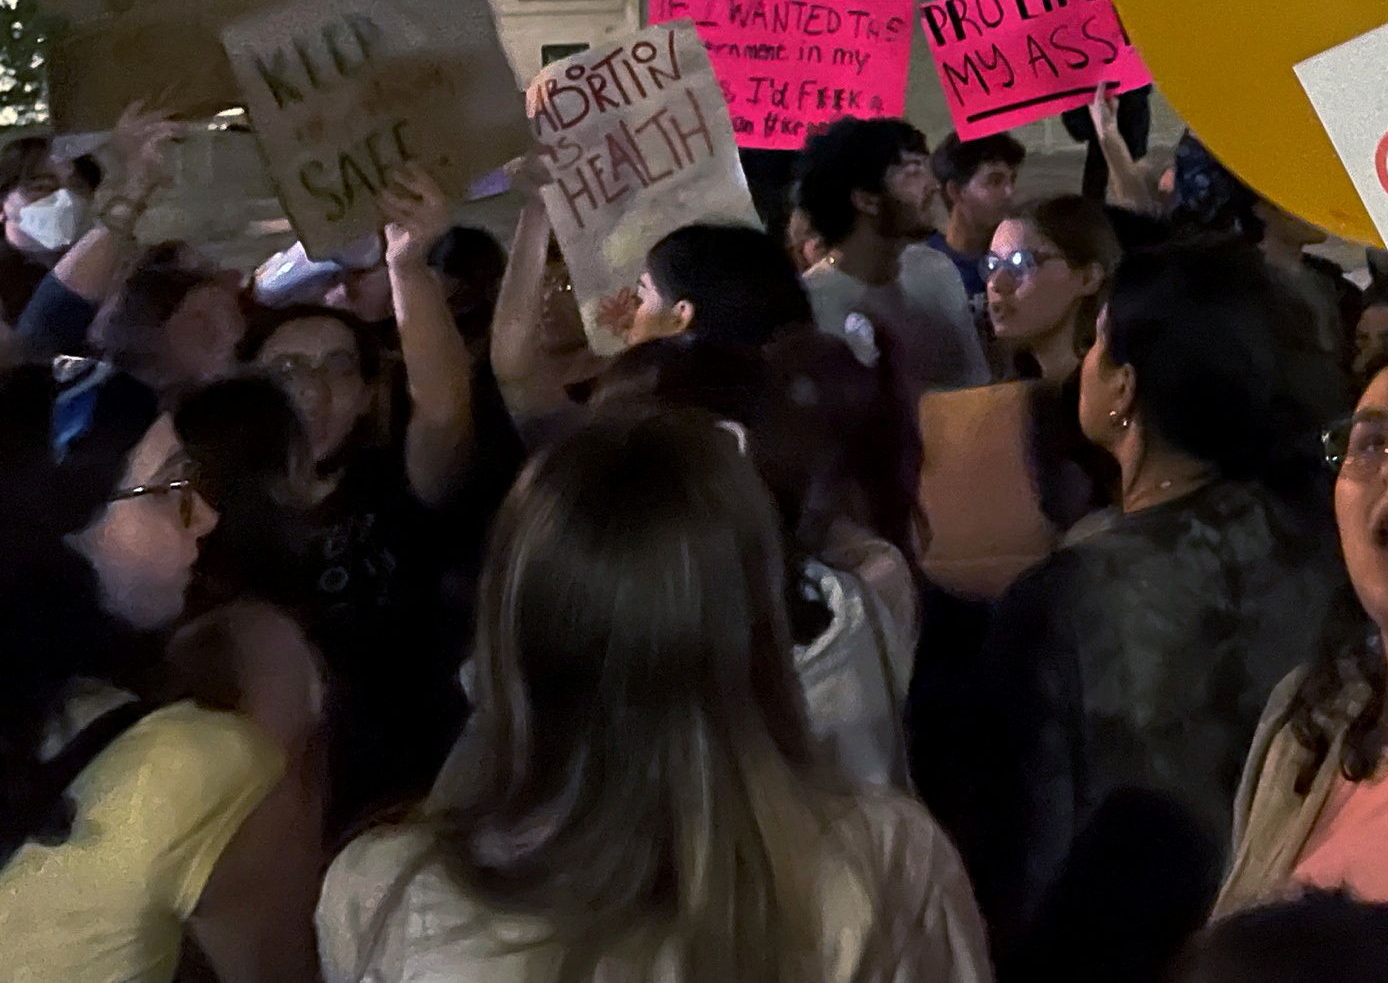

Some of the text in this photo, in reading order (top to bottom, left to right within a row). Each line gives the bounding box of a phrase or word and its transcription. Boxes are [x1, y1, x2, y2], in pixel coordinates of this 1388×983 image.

[799, 40, 821, 64] in
[832, 46, 871, 76] my
[942, 43, 1015, 107] MY
[558, 87, 715, 228] HEALTH
